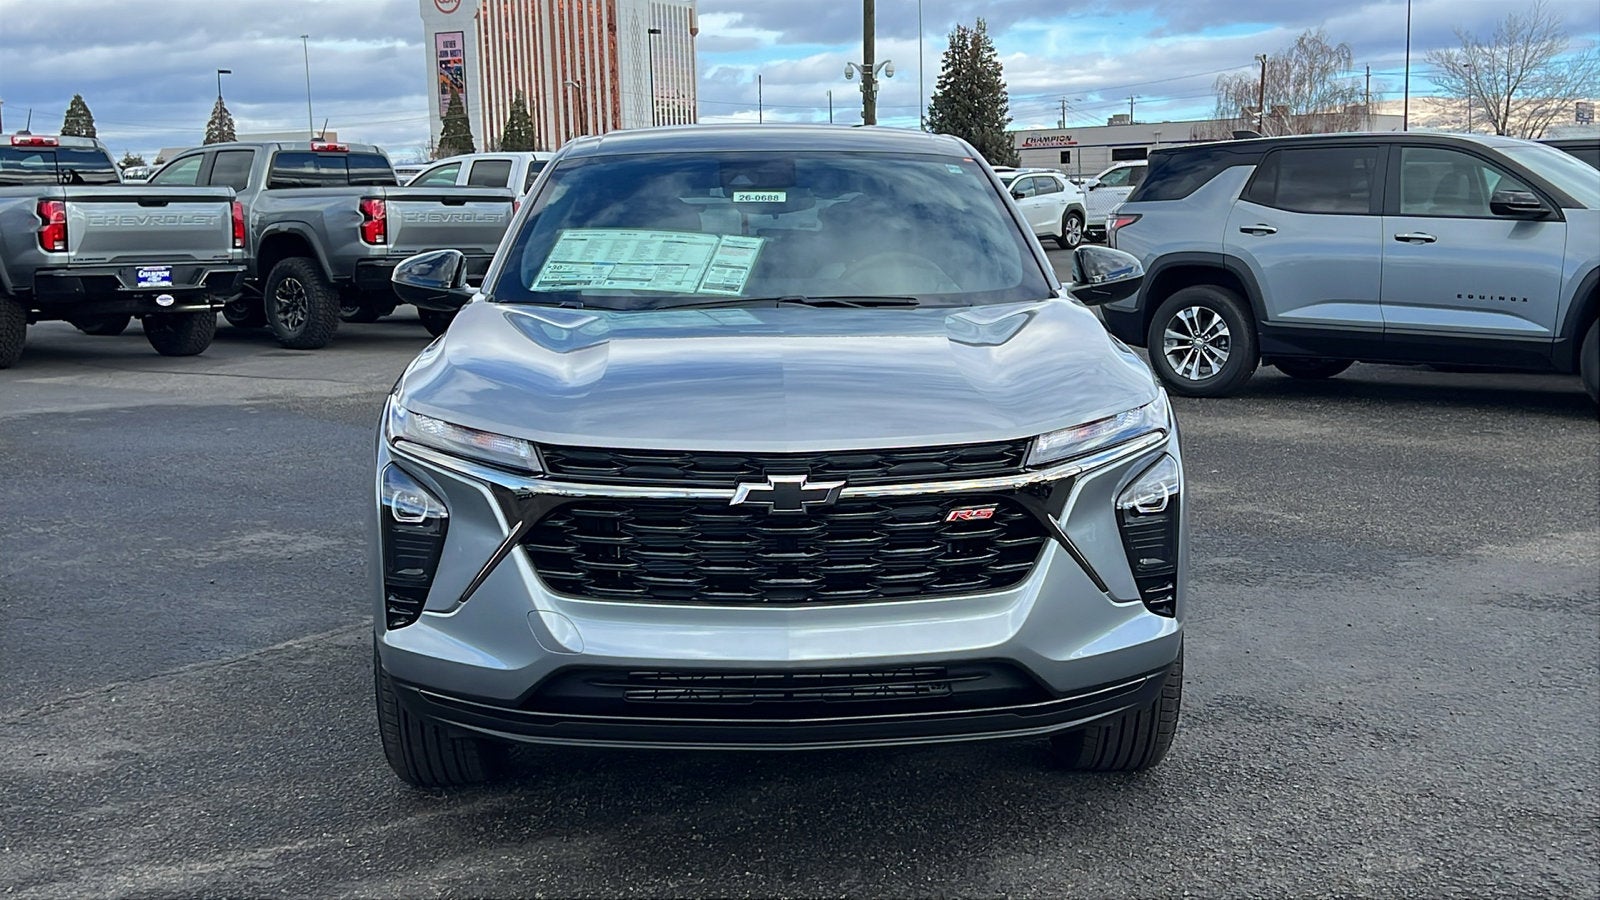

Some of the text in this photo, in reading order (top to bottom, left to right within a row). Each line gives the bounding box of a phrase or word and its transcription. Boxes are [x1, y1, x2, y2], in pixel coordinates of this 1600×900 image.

[1025, 135, 1072, 144] CHAMPION
[88, 215, 220, 226] CHEVROLET
[403, 212, 503, 223] CHEVROLET
[1456, 293, 1528, 302] EQUINOX
[945, 507, 996, 522] RS
